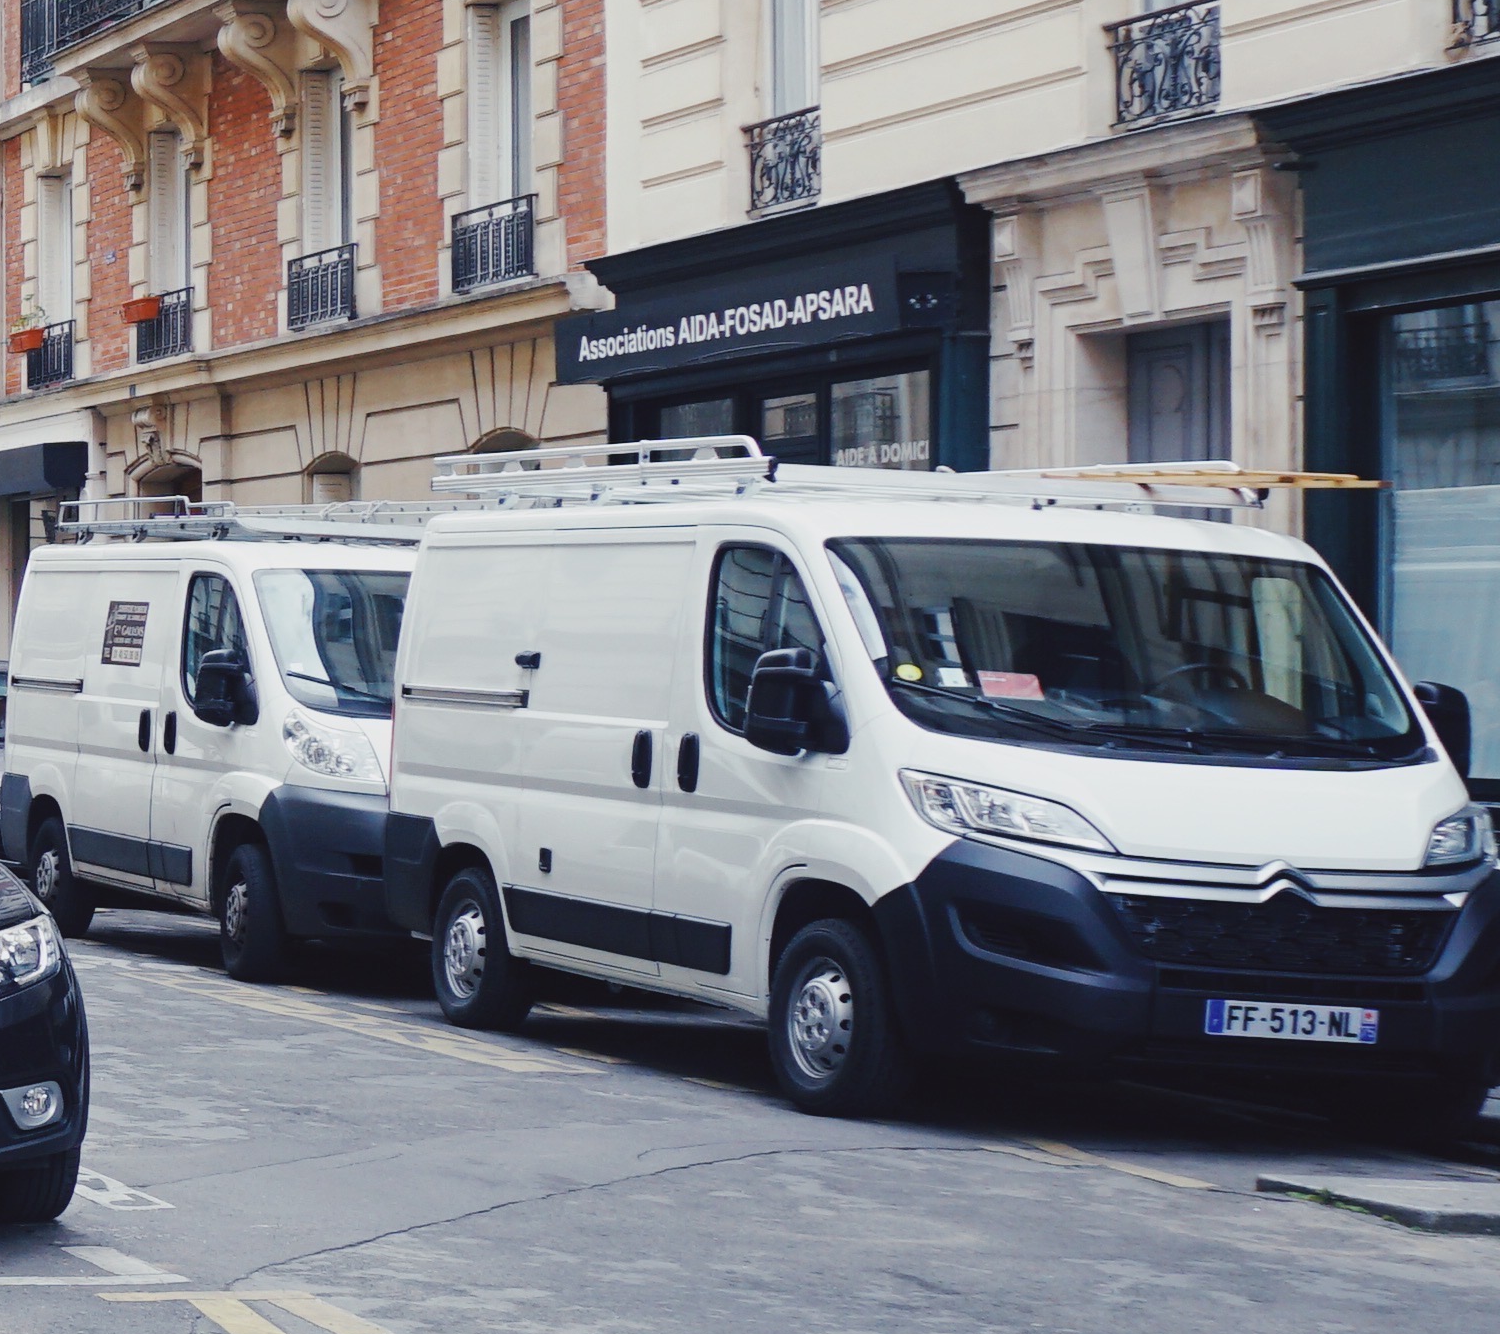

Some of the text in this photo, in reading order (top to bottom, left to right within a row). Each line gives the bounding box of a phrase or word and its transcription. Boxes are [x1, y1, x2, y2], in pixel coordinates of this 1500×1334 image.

[578, 283, 875, 363] Associations AIDA-FOSAD-APSARA
[836, 446, 866, 467] AIDE
[1226, 1005, 1358, 1038] FF-513-NL
